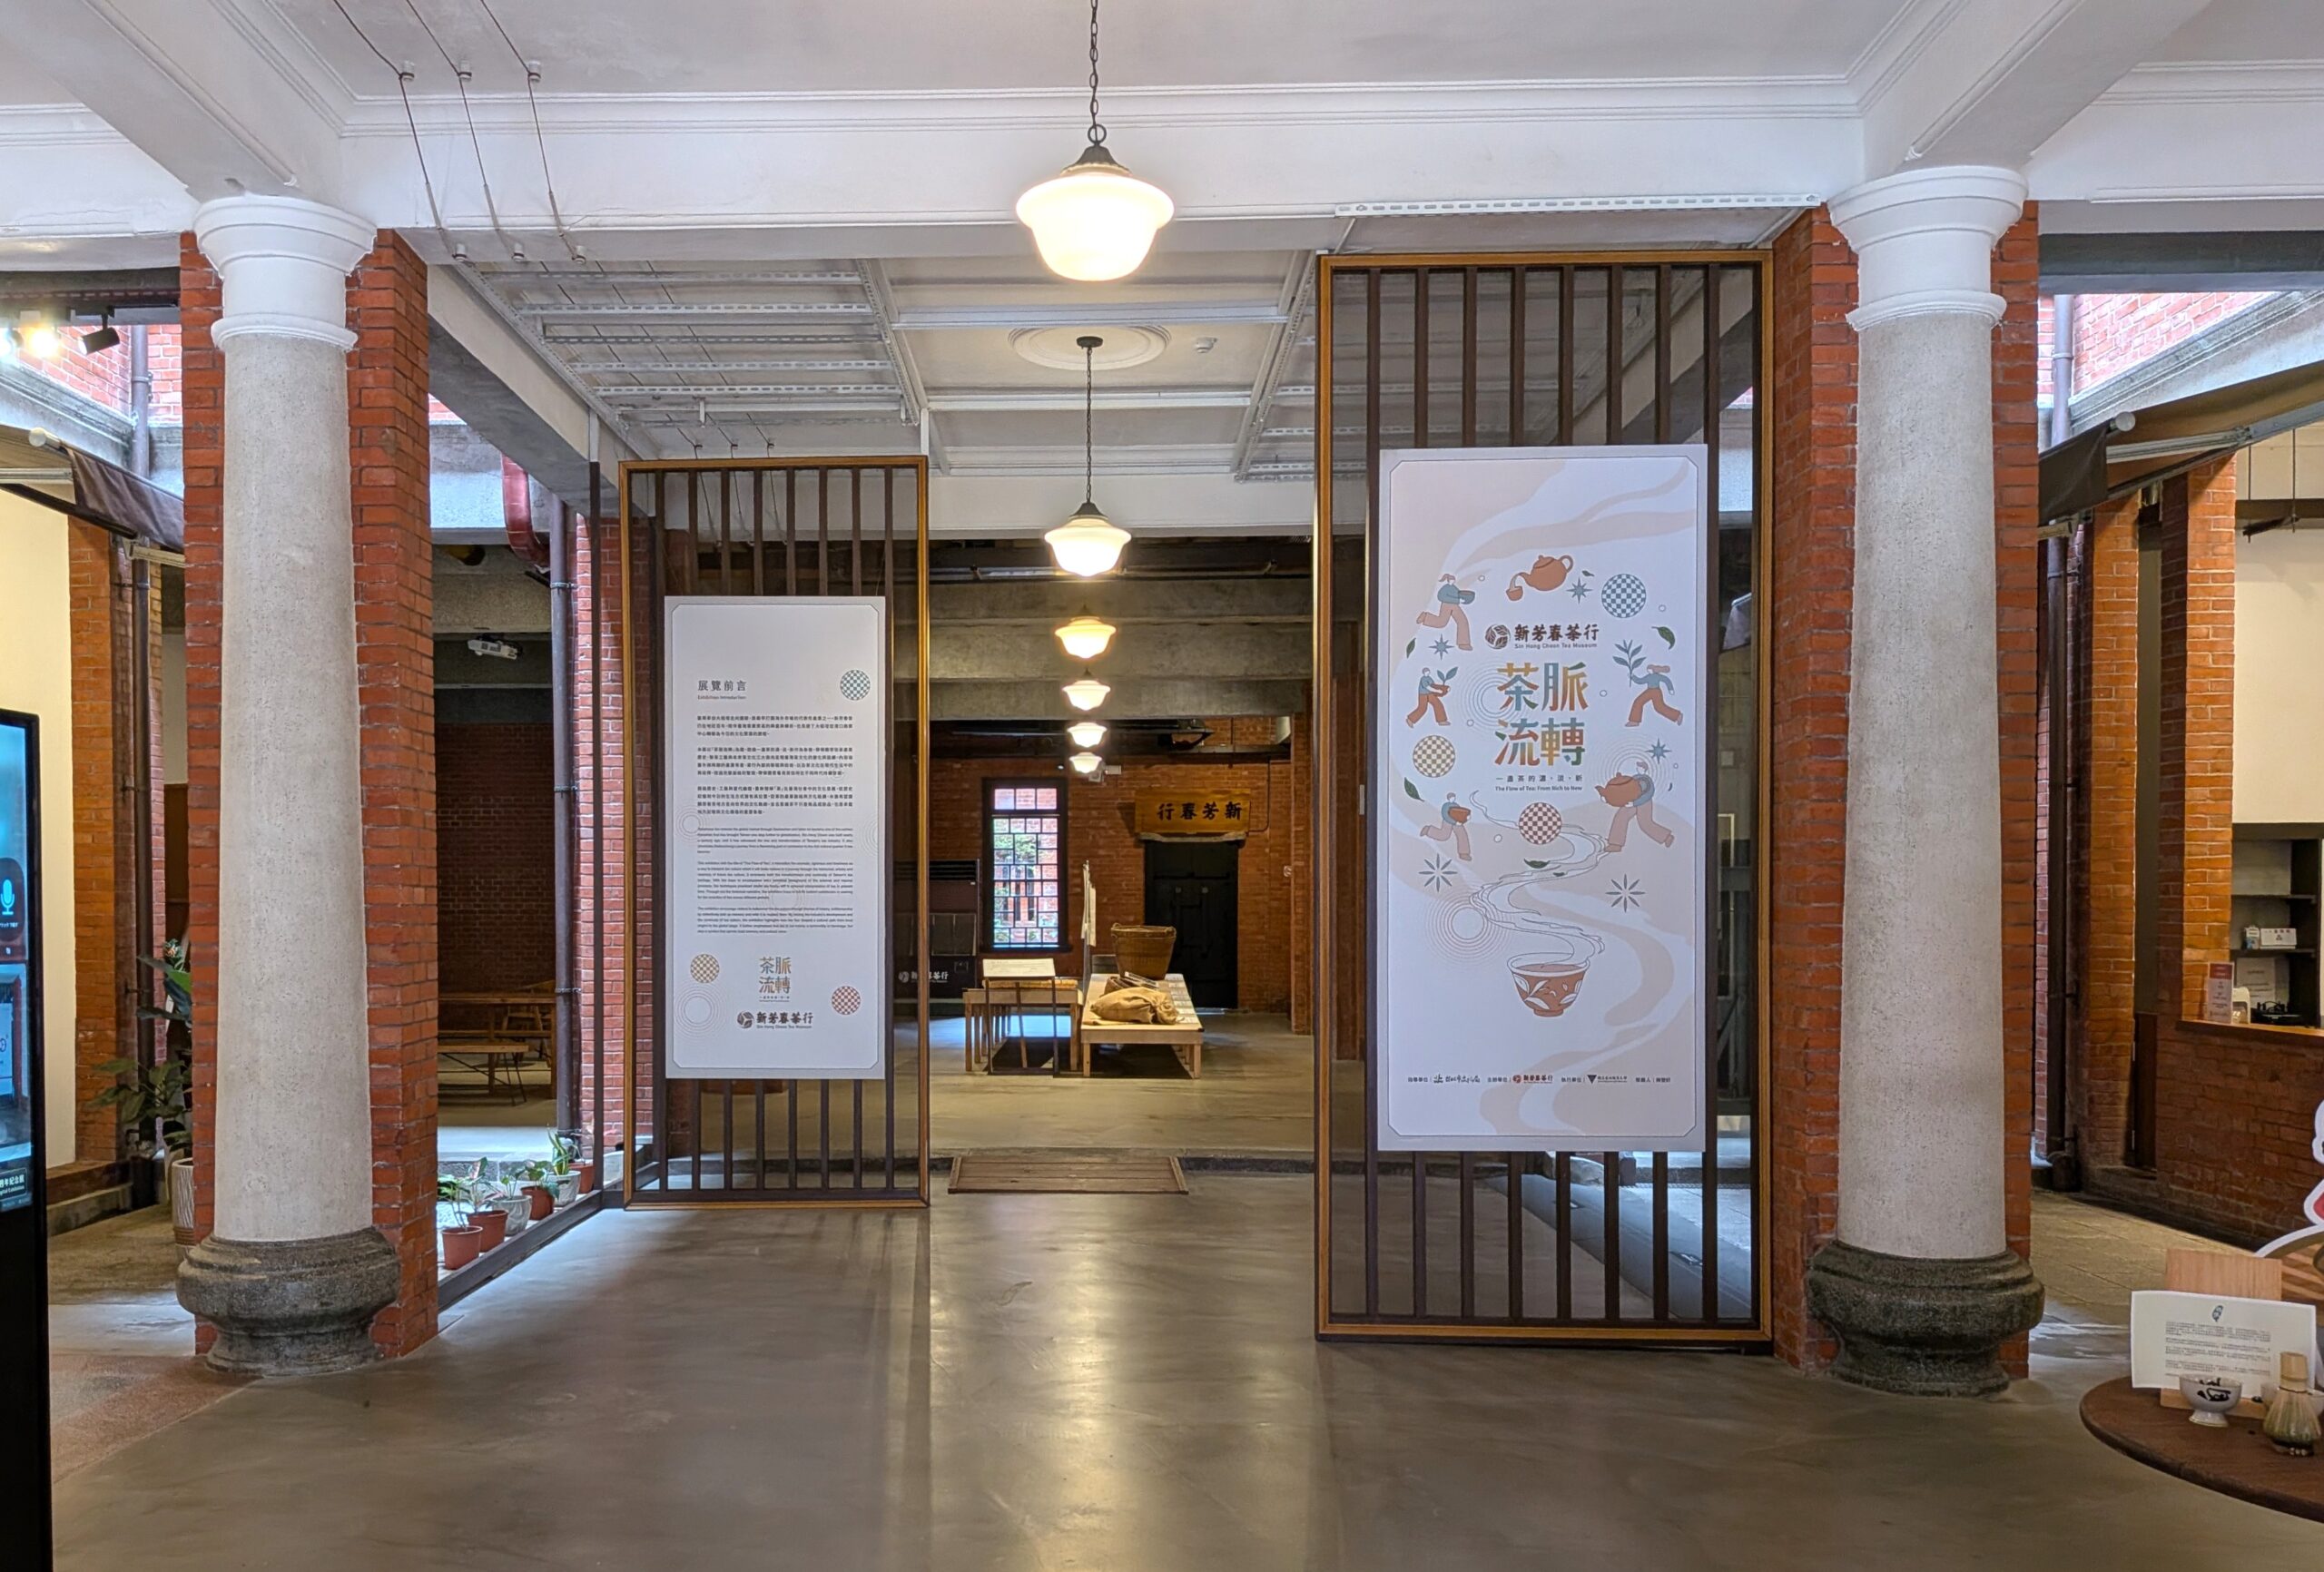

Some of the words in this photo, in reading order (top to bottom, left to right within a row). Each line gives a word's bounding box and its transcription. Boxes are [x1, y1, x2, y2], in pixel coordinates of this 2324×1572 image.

[1514, 624, 1600, 643] 新芳春茶行
[697, 680, 747, 691] 展覽前言
[1497, 662, 1589, 712] 茶脈
[1494, 717, 1586, 767] 流轉
[759, 957, 792, 974] 茶脈
[759, 976, 792, 994] 流轉
[756, 1011, 813, 1024] 新芳春茶行
